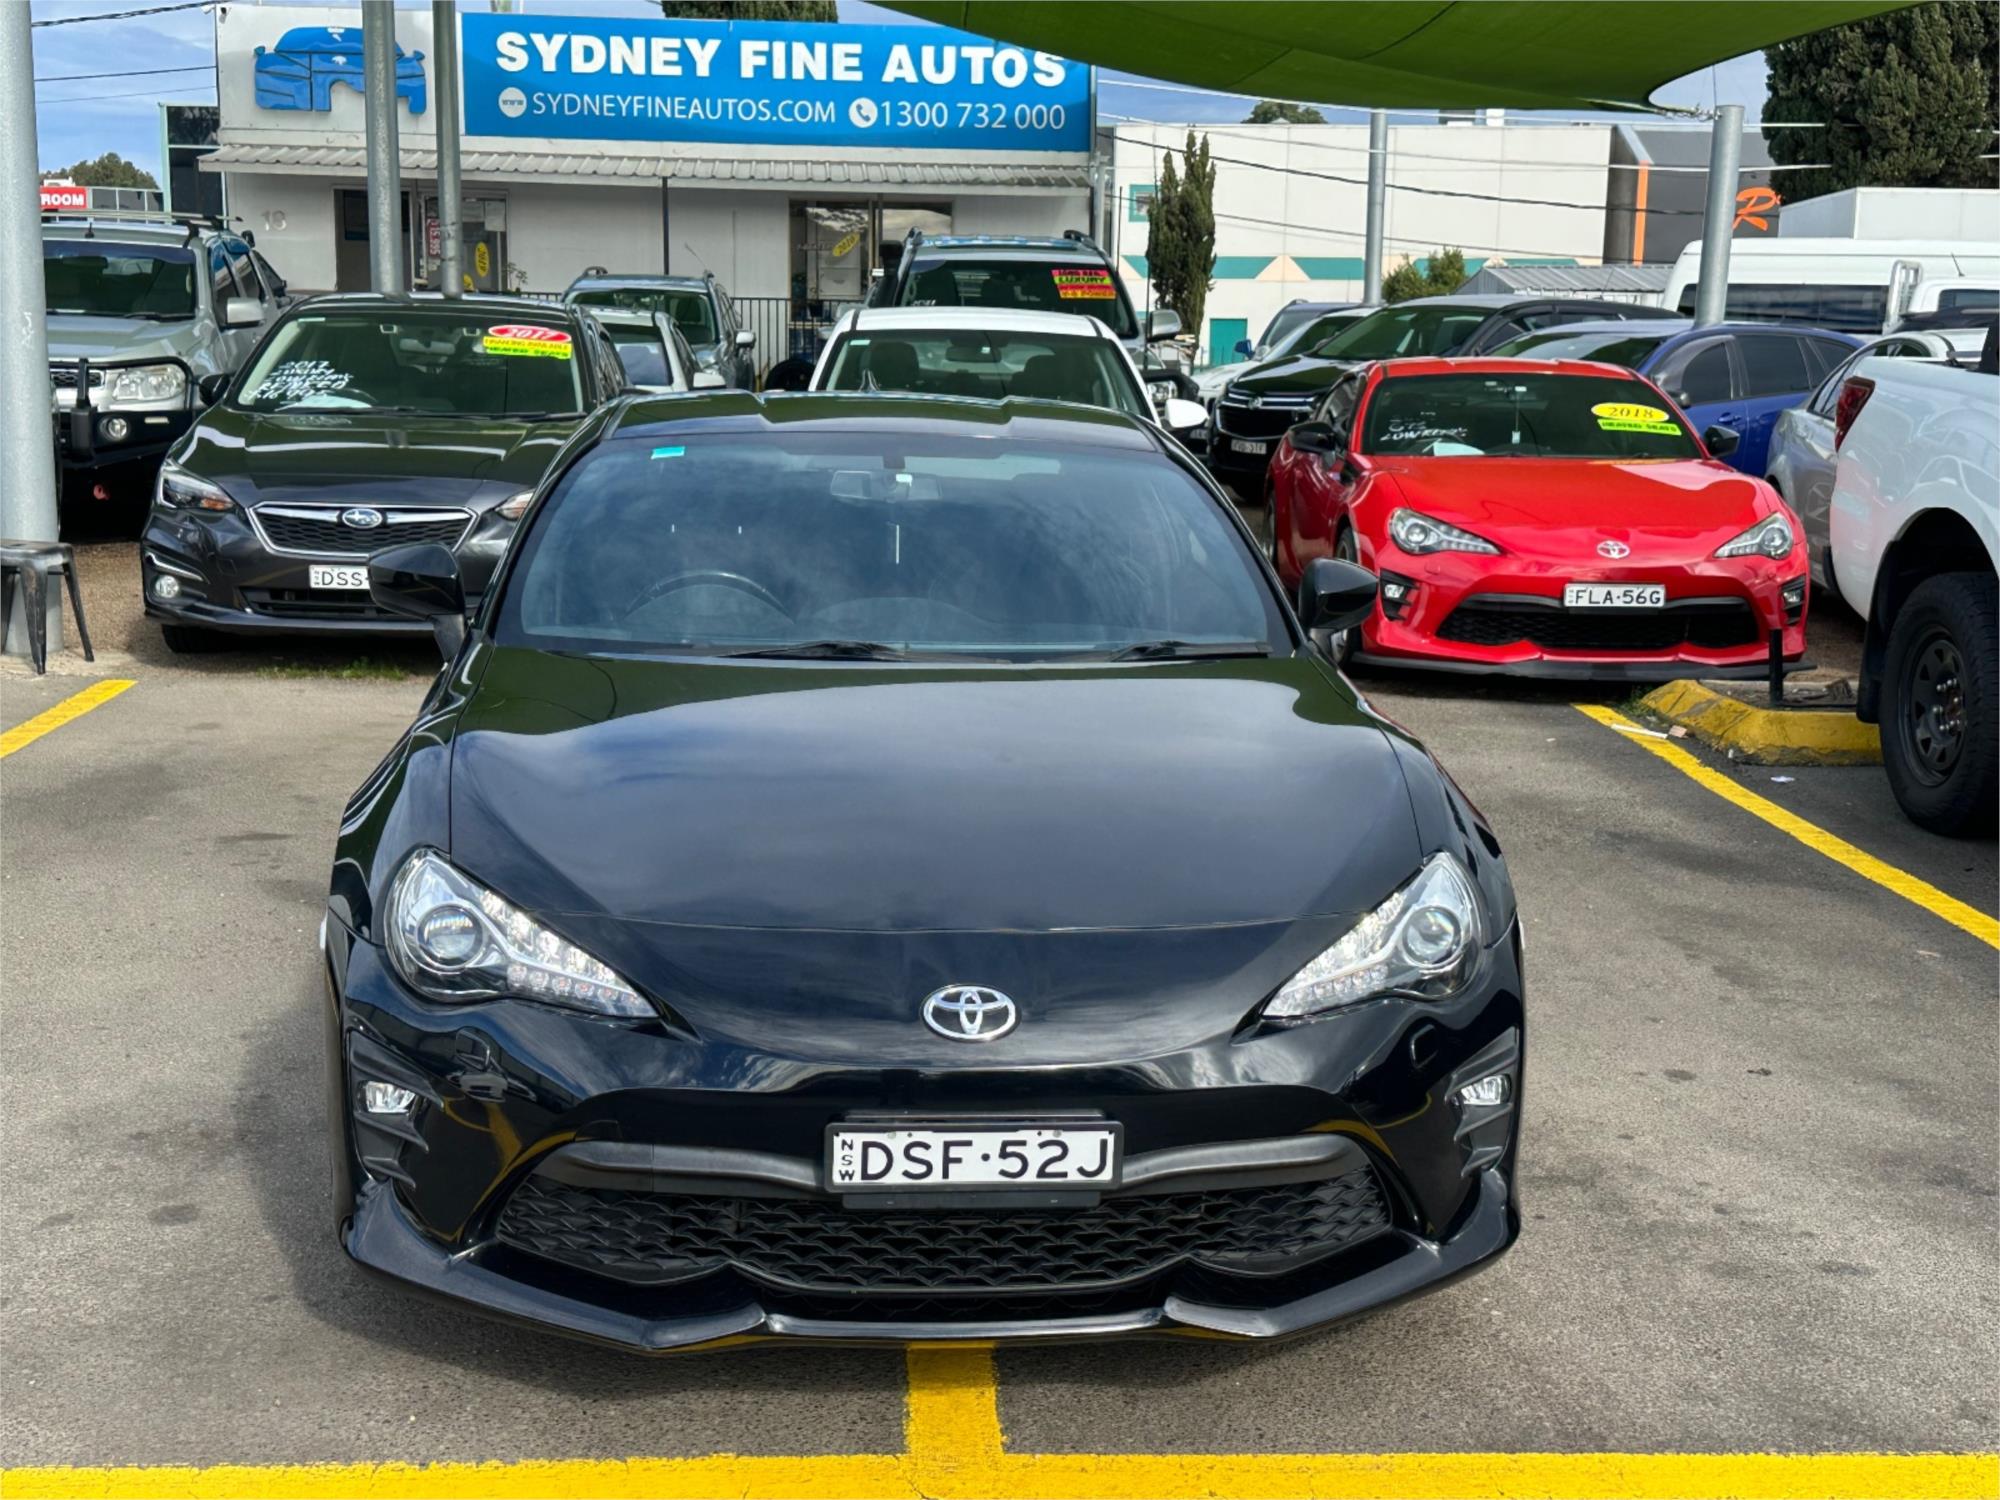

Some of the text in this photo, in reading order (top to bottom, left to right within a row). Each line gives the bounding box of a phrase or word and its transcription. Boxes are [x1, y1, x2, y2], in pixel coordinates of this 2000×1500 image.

[496, 31, 1066, 88] SYDNEY FINE AUTOS
[532, 91, 836, 123] SYDNEYFINEAUTOS.COM
[881, 100, 1066, 130] 1300 732 000
[1608, 407, 1654, 418] 2018
[839, 1139, 855, 1181] NSW
